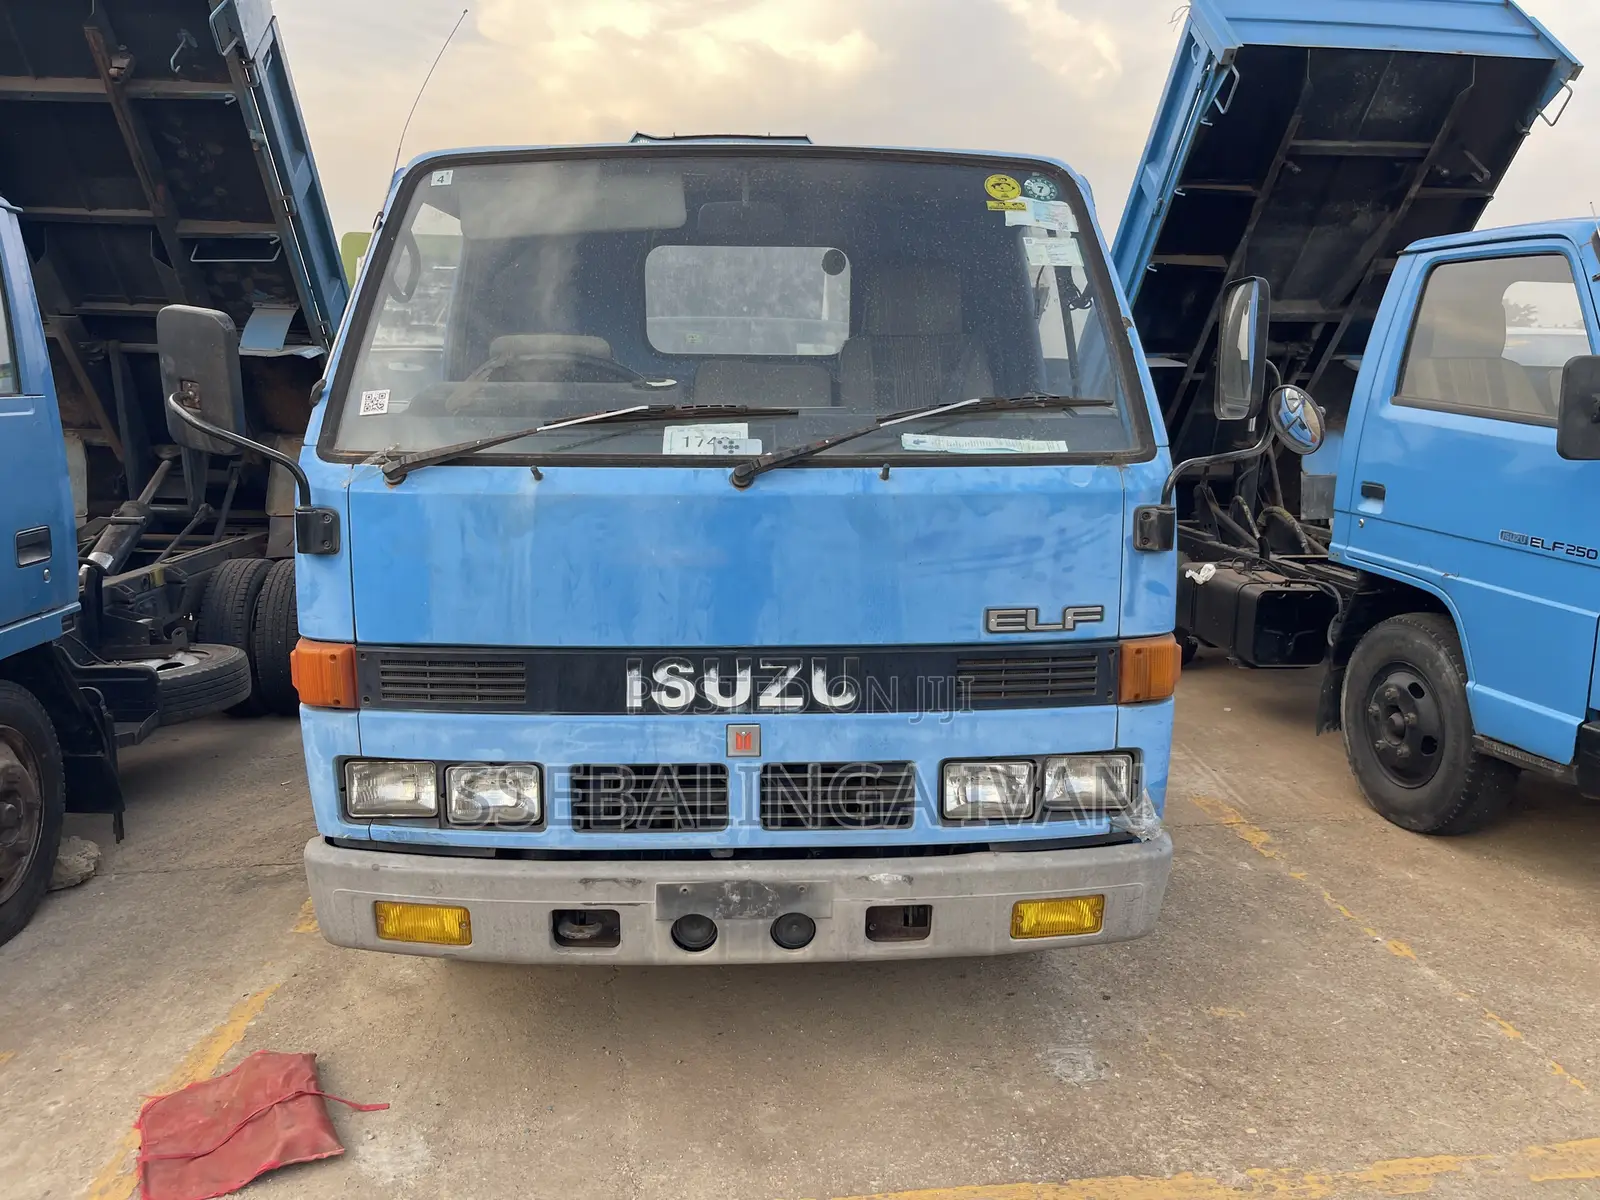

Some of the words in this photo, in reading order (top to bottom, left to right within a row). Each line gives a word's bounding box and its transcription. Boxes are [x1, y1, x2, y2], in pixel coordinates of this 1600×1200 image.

[437, 175, 444, 183] 4
[682, 436, 730, 448] 174
[1500, 530, 1528, 546] ISUZU
[986, 605, 1103, 633] ELF
[625, 657, 859, 708] ISUZU
